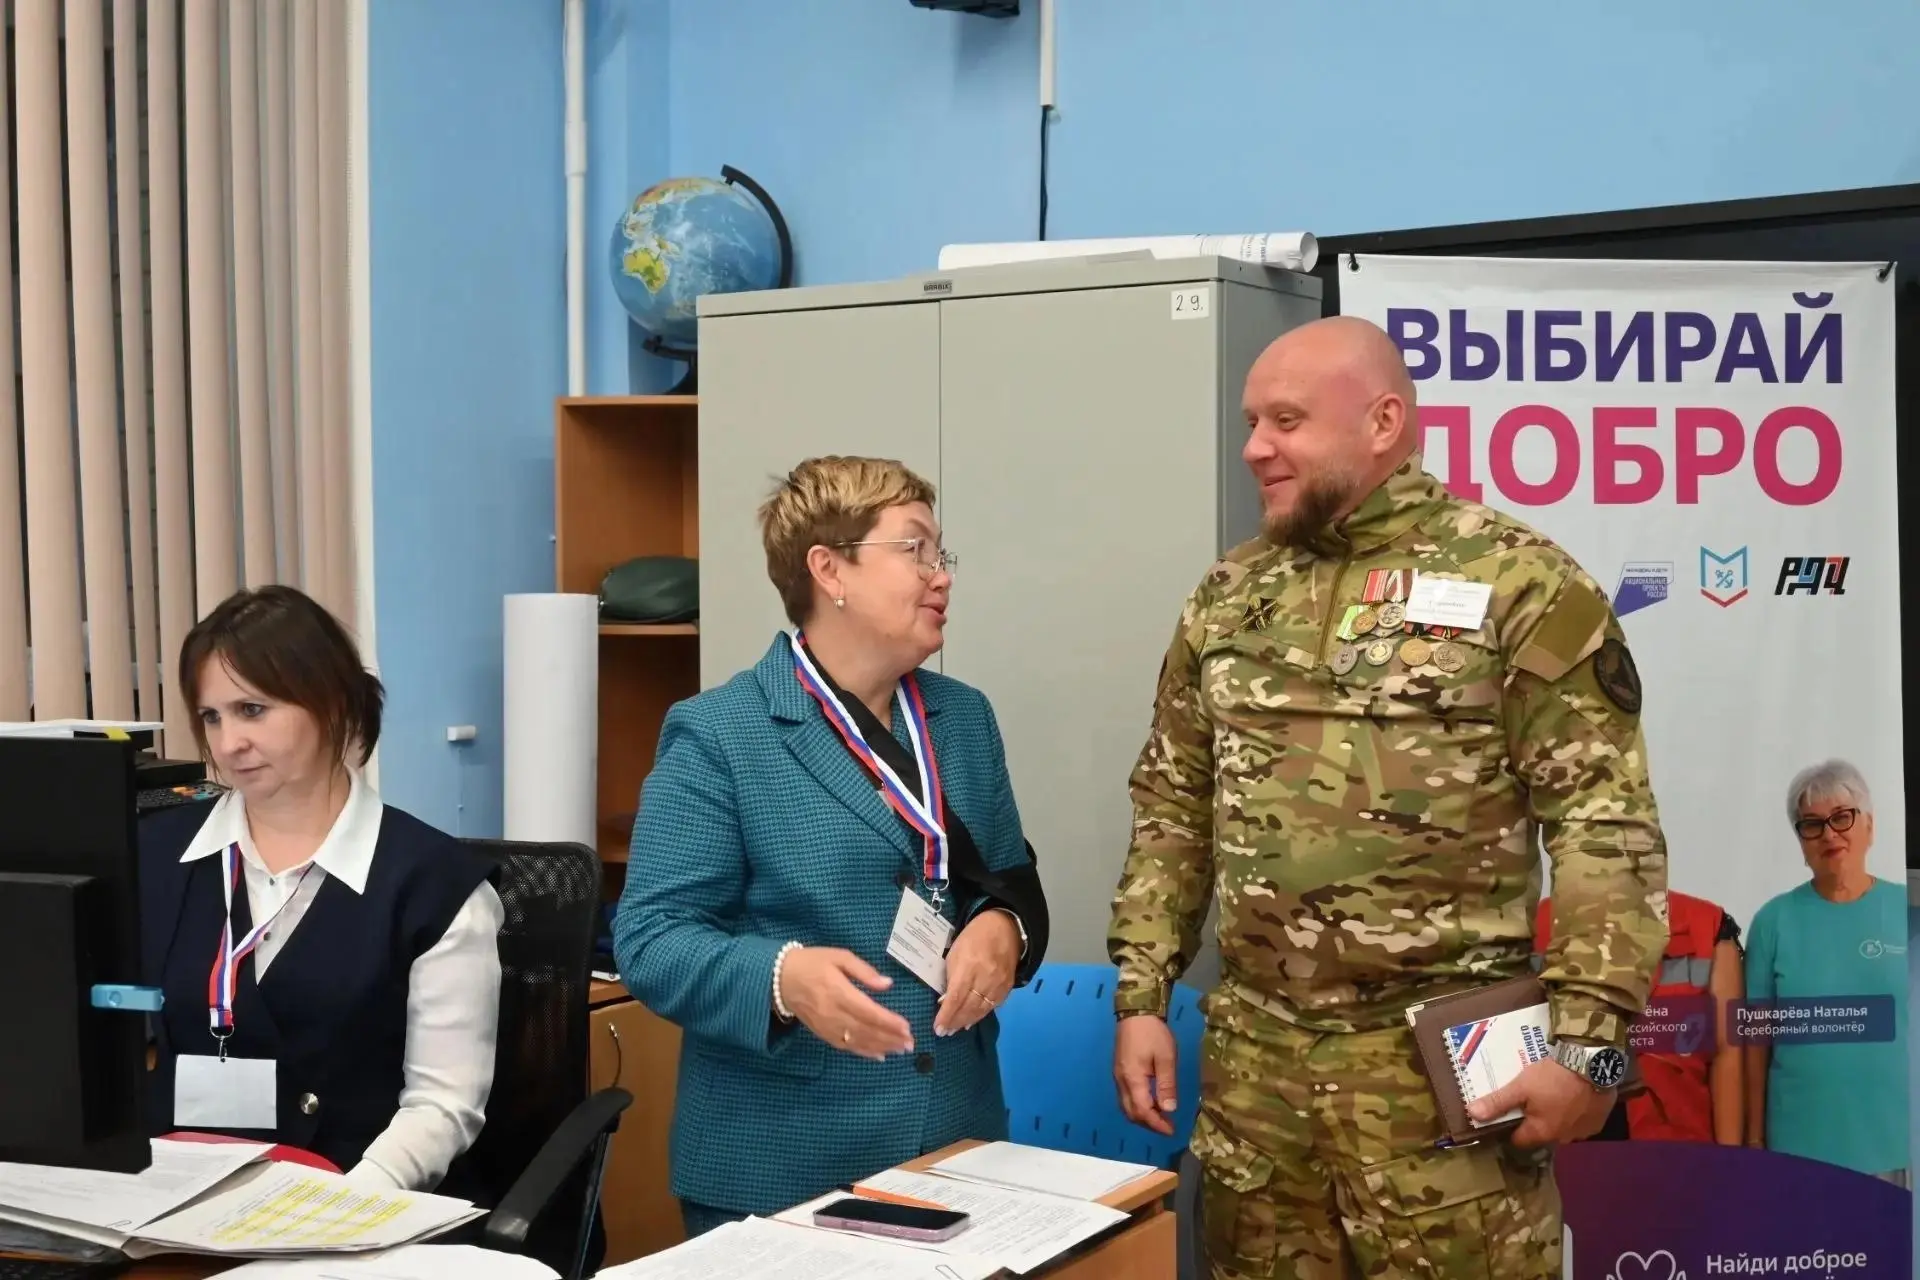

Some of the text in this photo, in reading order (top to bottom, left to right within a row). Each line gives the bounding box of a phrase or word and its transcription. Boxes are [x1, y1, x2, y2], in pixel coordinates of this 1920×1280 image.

[1387, 291, 1843, 384] ВЫБИРАЙ
[1416, 404, 1843, 507] ДОБРО
[1737, 1005, 1868, 1023] Пушкарёва Наталья
[1737, 1021, 1866, 1038] Серебряный волонтёр
[1706, 1249, 1868, 1275] Найди доброе
